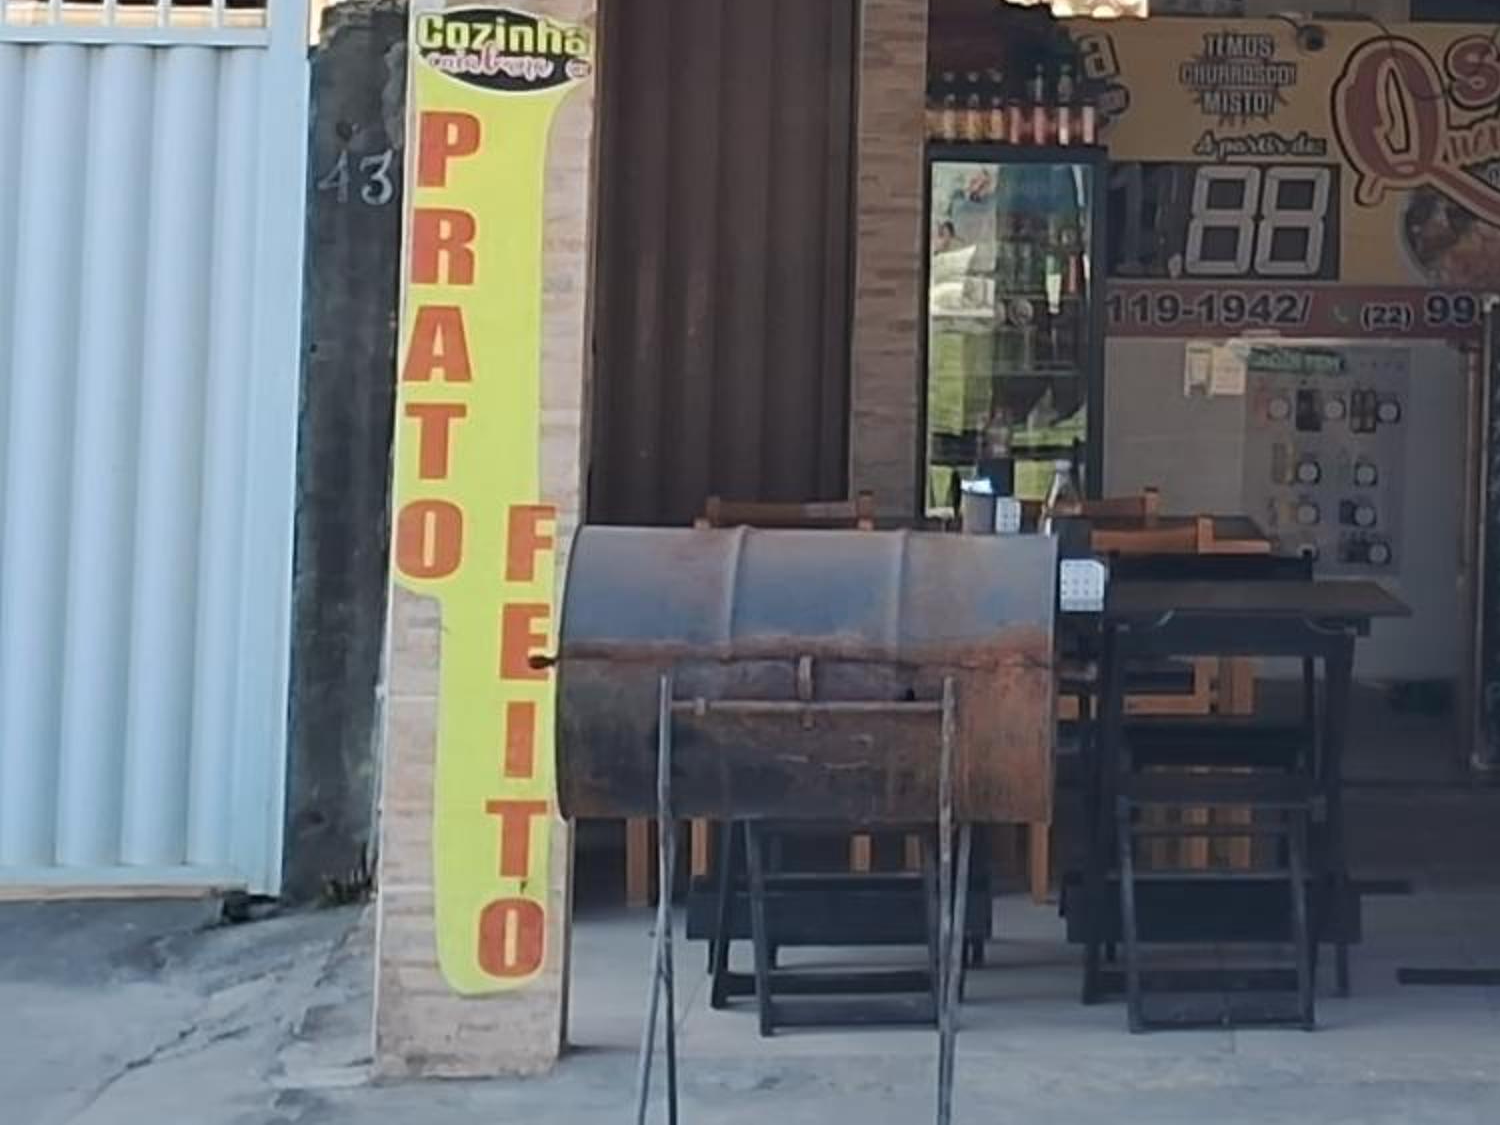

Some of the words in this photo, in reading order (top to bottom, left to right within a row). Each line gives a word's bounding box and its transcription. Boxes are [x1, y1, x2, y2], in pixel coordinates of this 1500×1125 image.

[417, 14, 592, 56] Cozinha
[316, 147, 395, 206] 43
[1361, 305, 1413, 328] (22)
[1424, 293, 1482, 325] 99
[395, 111, 481, 579] PRATO
[477, 504, 558, 980] FEITO
